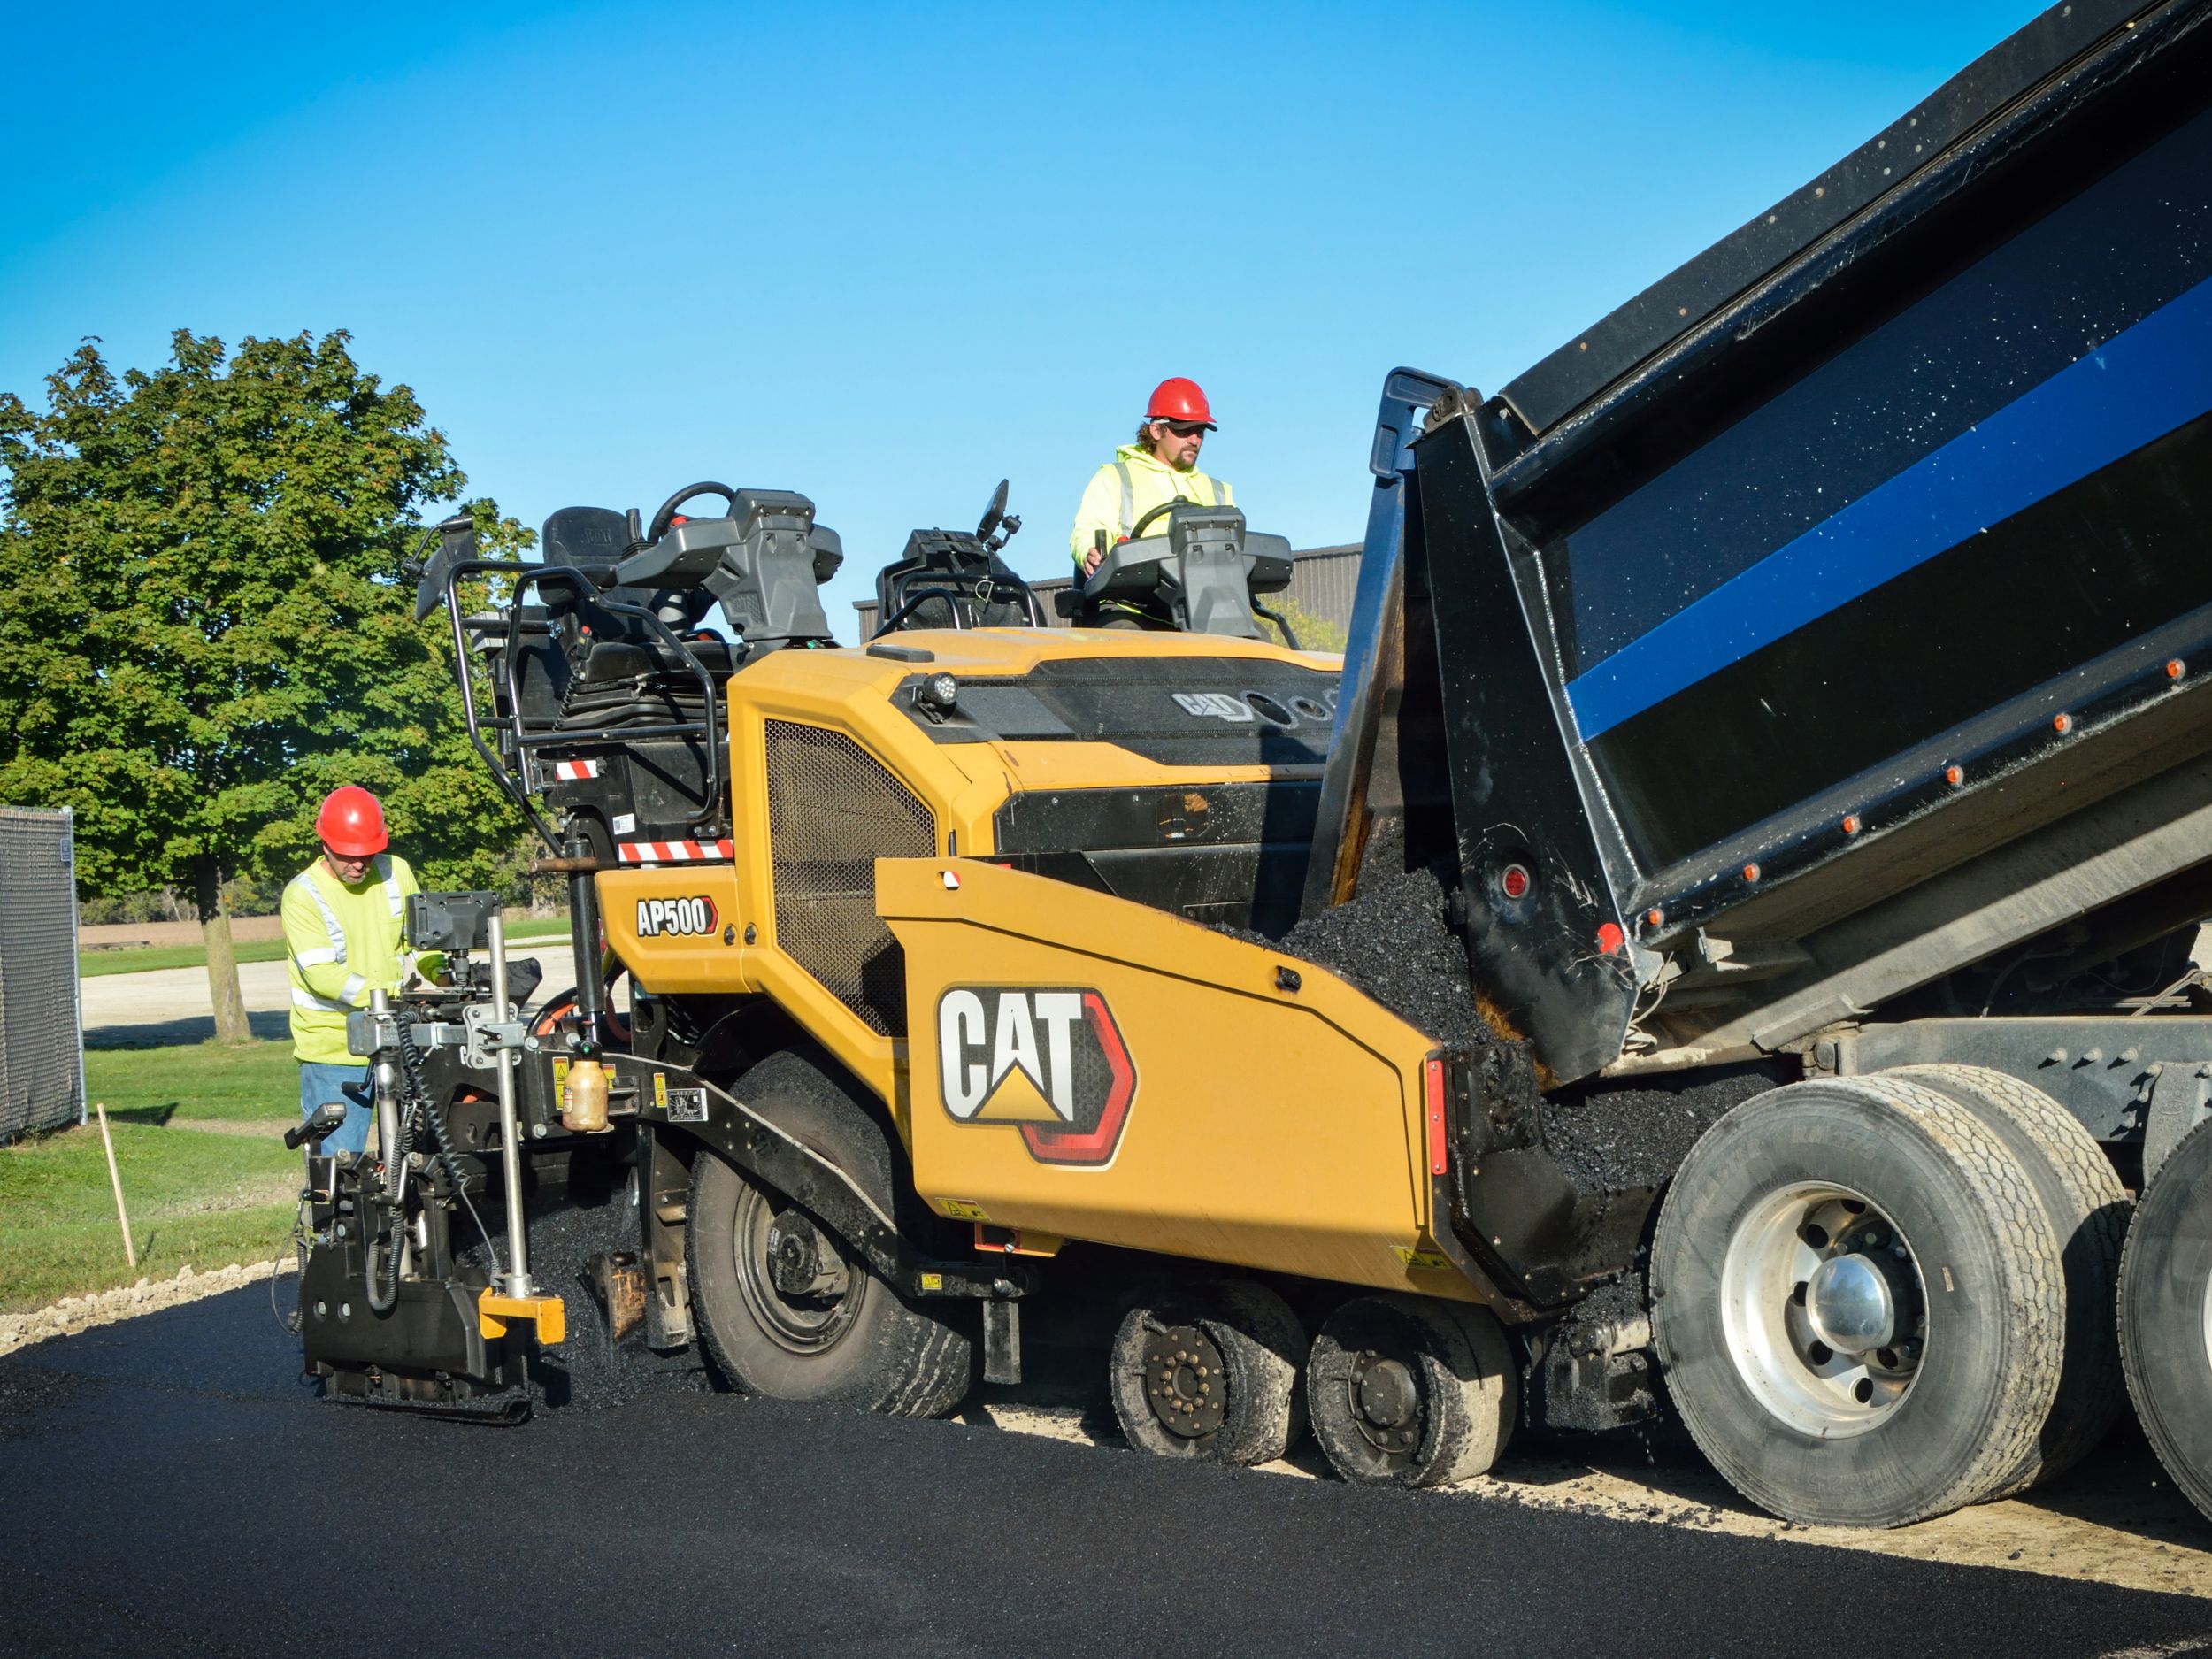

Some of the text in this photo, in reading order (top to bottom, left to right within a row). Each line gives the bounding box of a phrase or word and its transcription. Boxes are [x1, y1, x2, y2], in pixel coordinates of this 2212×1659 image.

[1171, 693, 1237, 717] CAT
[637, 897, 706, 936] AP500
[940, 989, 1082, 1122] CAT
